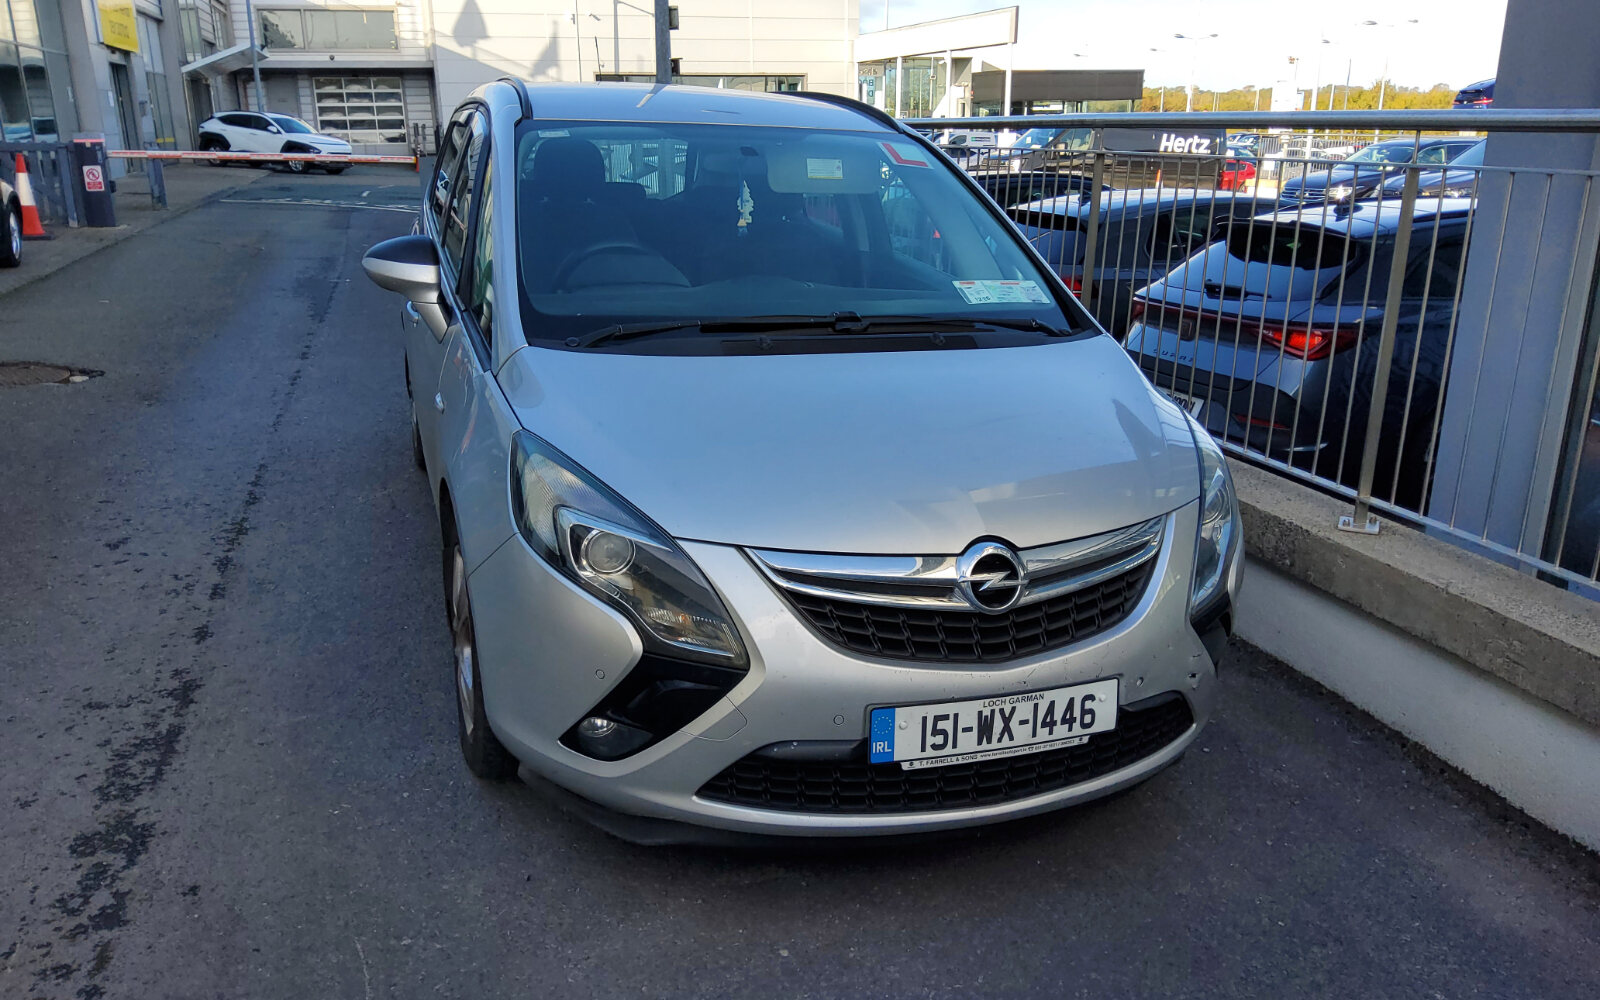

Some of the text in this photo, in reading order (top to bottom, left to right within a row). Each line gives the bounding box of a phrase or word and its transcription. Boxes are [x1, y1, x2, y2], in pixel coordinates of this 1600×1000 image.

[982, 693, 1045, 709] LOCH GARMAN
[920, 693, 1097, 753] 151-WX-1446
[872, 741, 892, 754] IRL
[926, 757, 955, 766] FARRELL
[961, 754, 978, 762] SONS
